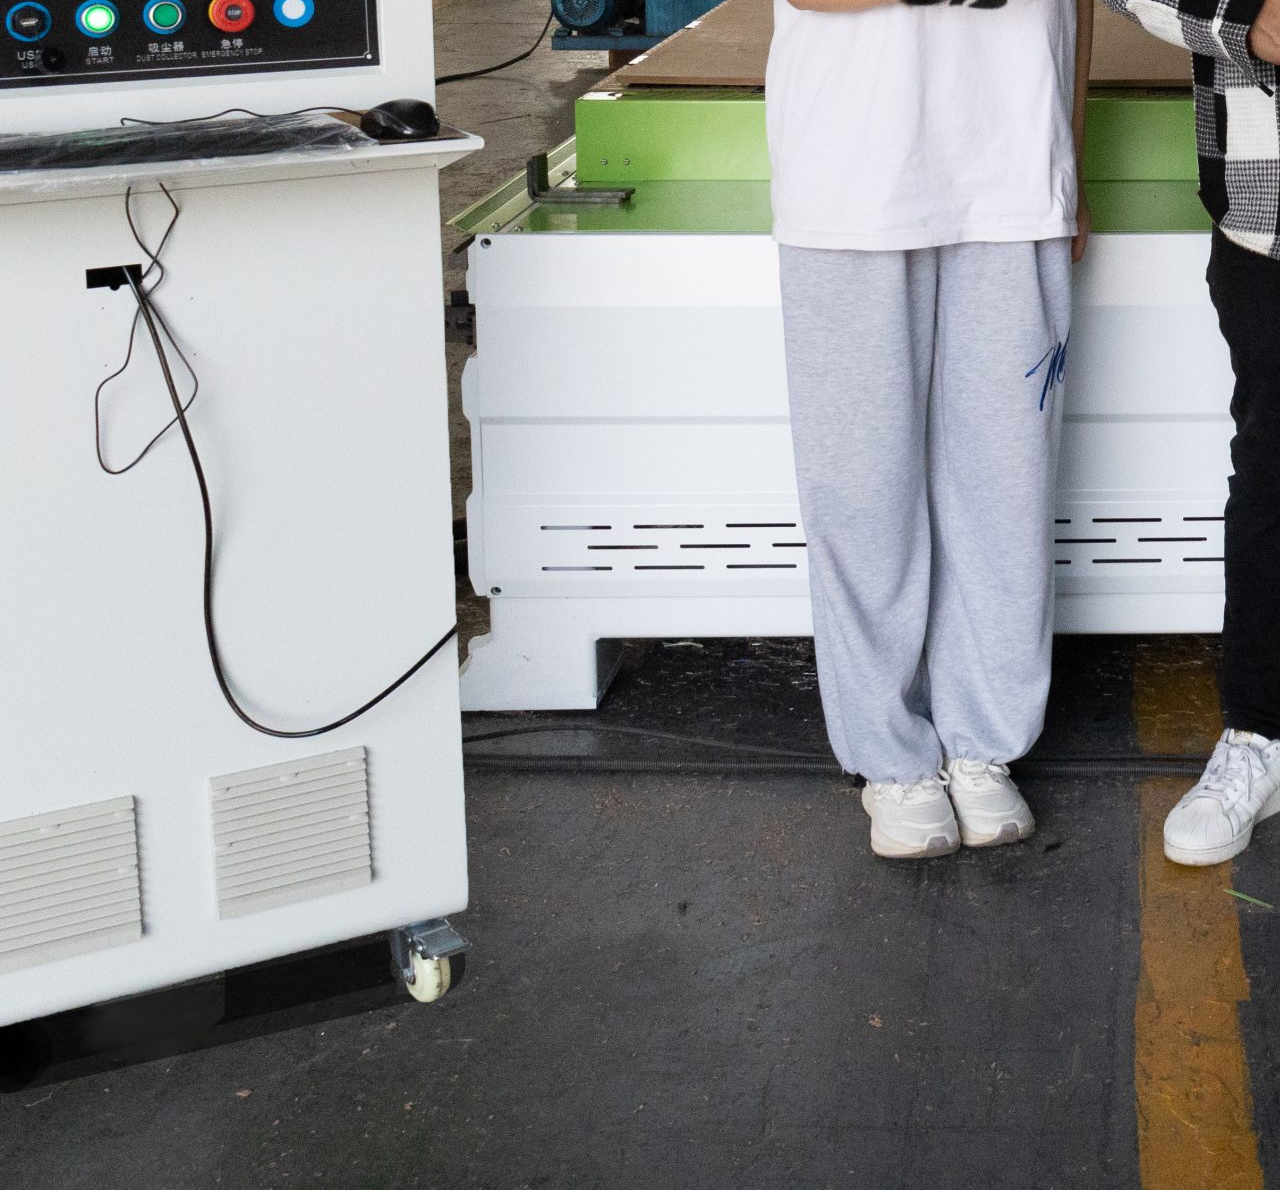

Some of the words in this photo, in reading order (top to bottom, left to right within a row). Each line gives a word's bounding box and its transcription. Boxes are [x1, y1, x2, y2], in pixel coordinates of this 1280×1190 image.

[148, 41, 184, 53] 吸尘器
[221, 38, 243, 49] 急停
[88, 45, 112, 56] 启动
[201, 48, 243, 58] EMERGENCY
[245, 47, 263, 56] STOP
[86, 56, 114, 65] START
